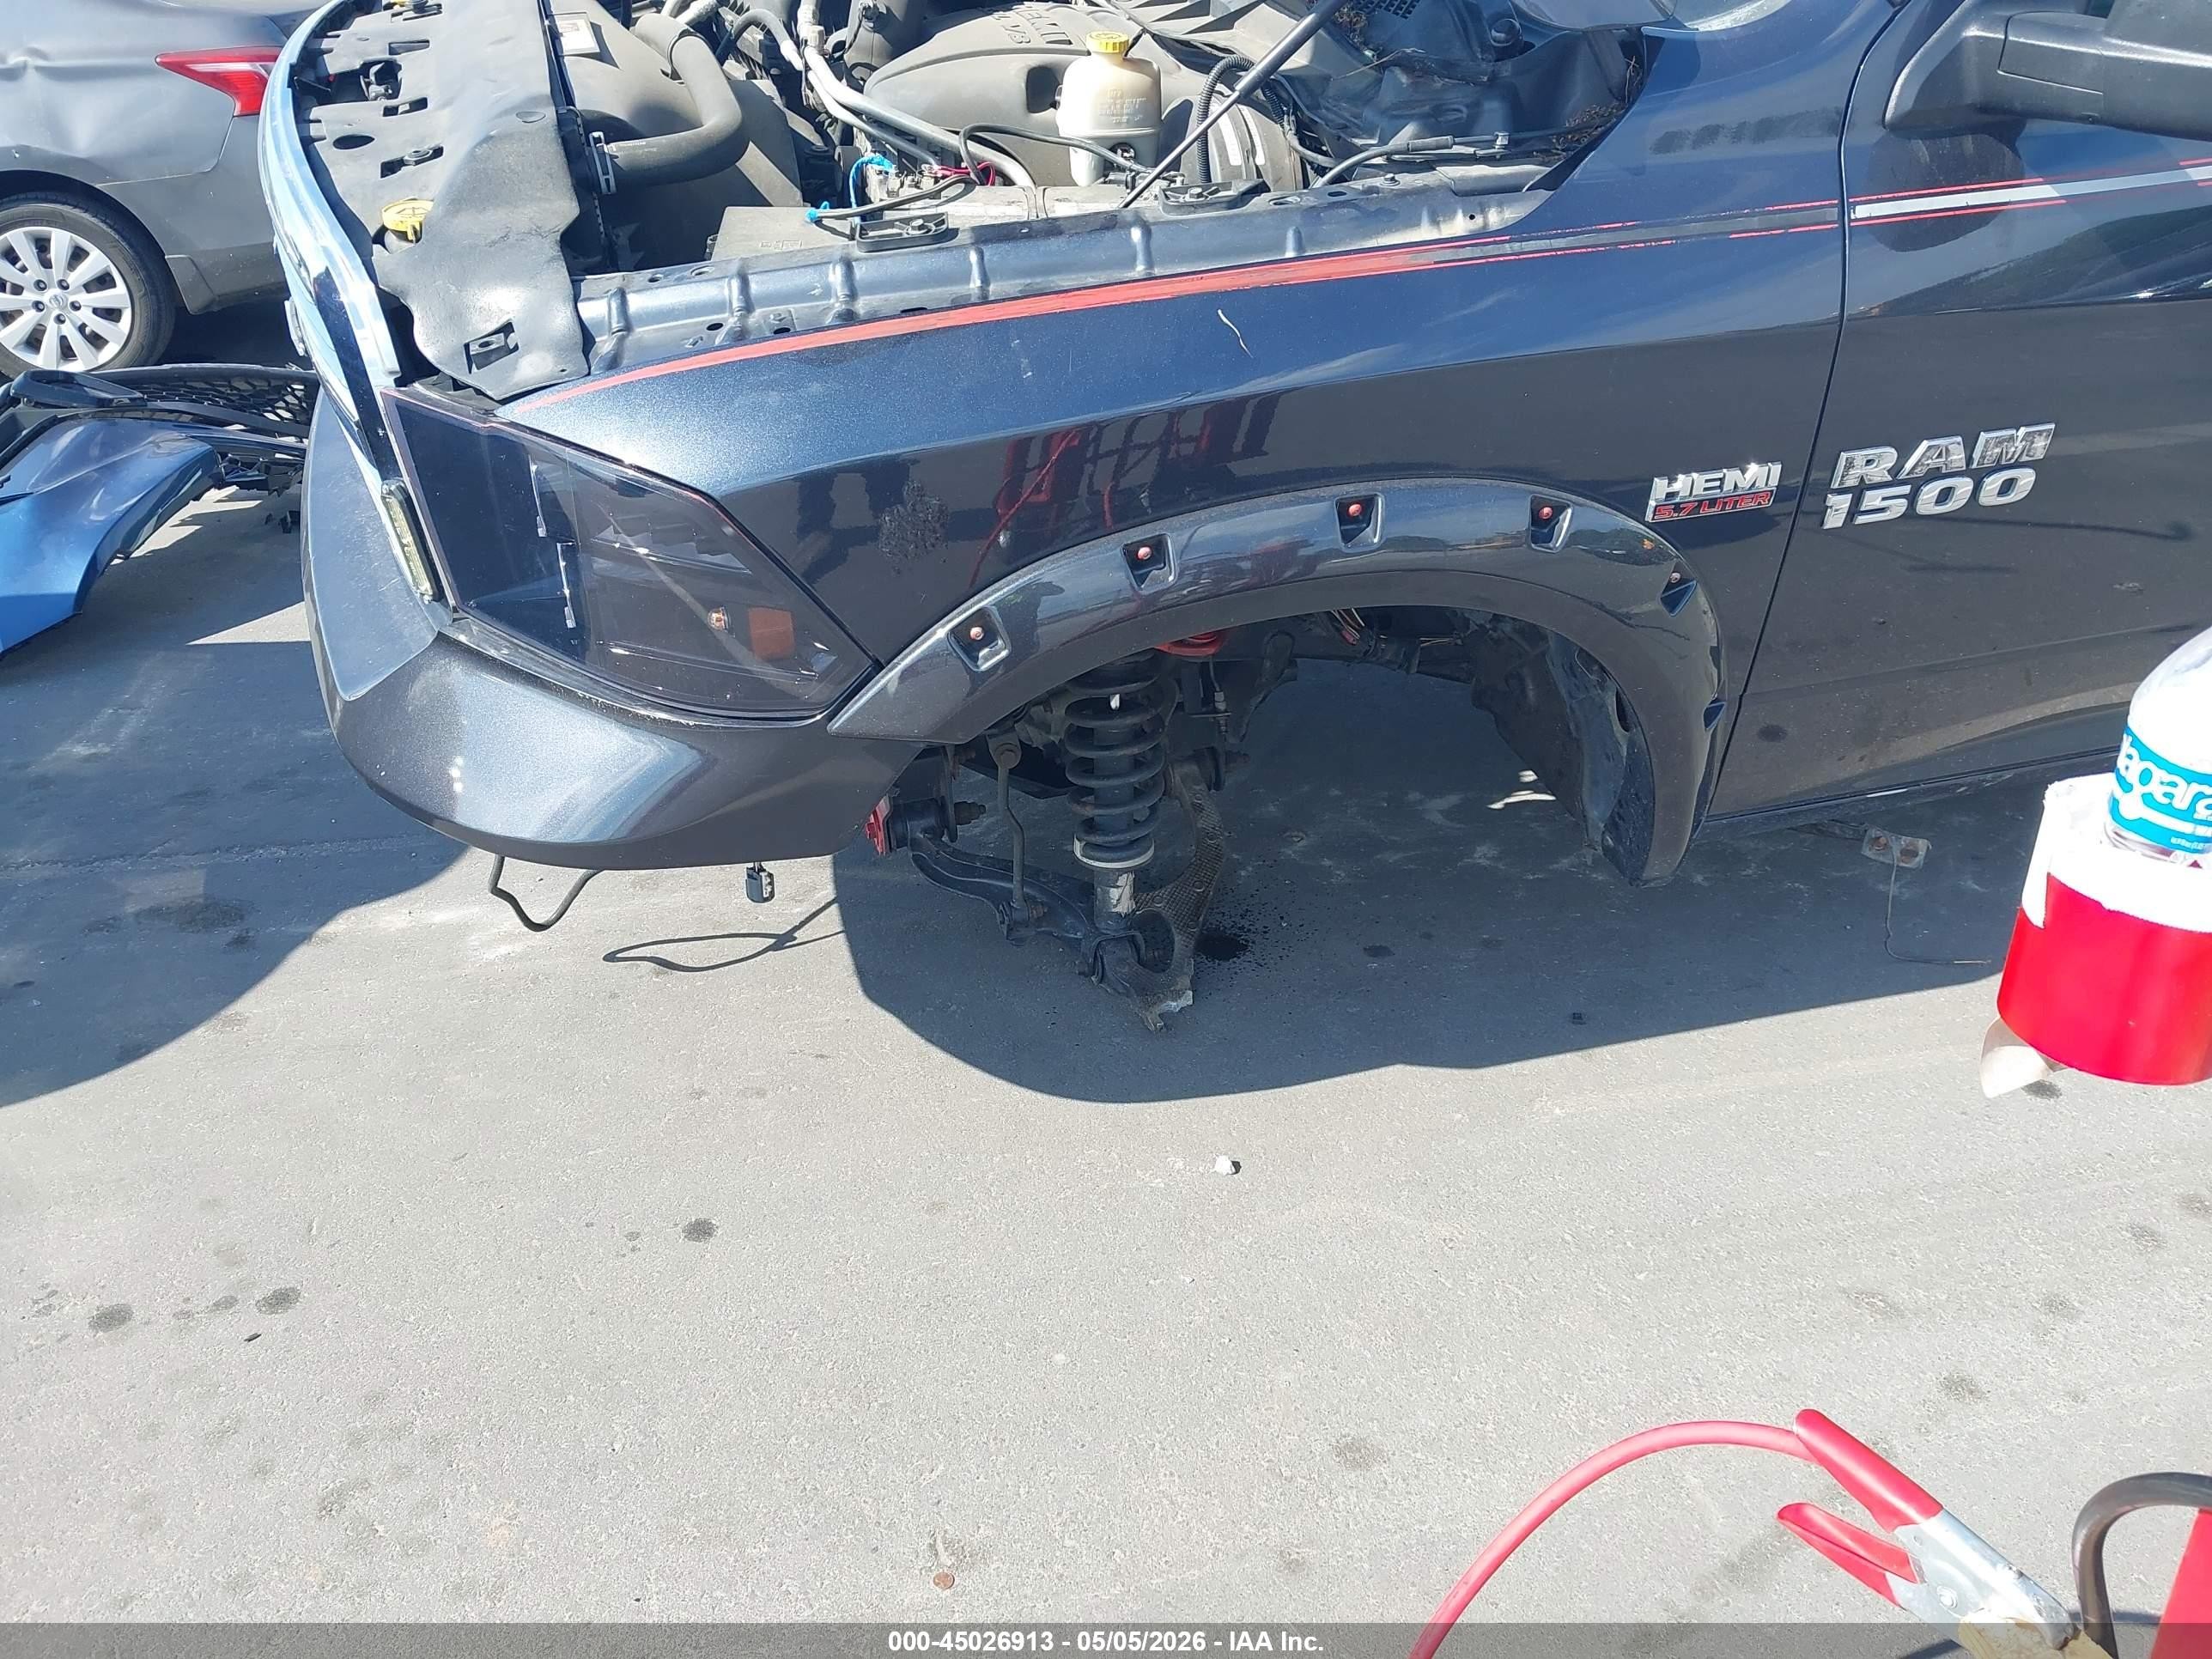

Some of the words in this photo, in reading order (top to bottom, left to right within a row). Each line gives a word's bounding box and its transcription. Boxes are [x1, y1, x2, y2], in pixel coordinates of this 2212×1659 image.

[1650, 461, 1782, 503] HEMI
[1830, 422, 2056, 489] RAM
[1654, 501, 1698, 520] 5.7
[1699, 491, 1772, 514] LITER
[1822, 466, 2037, 530] 1500
